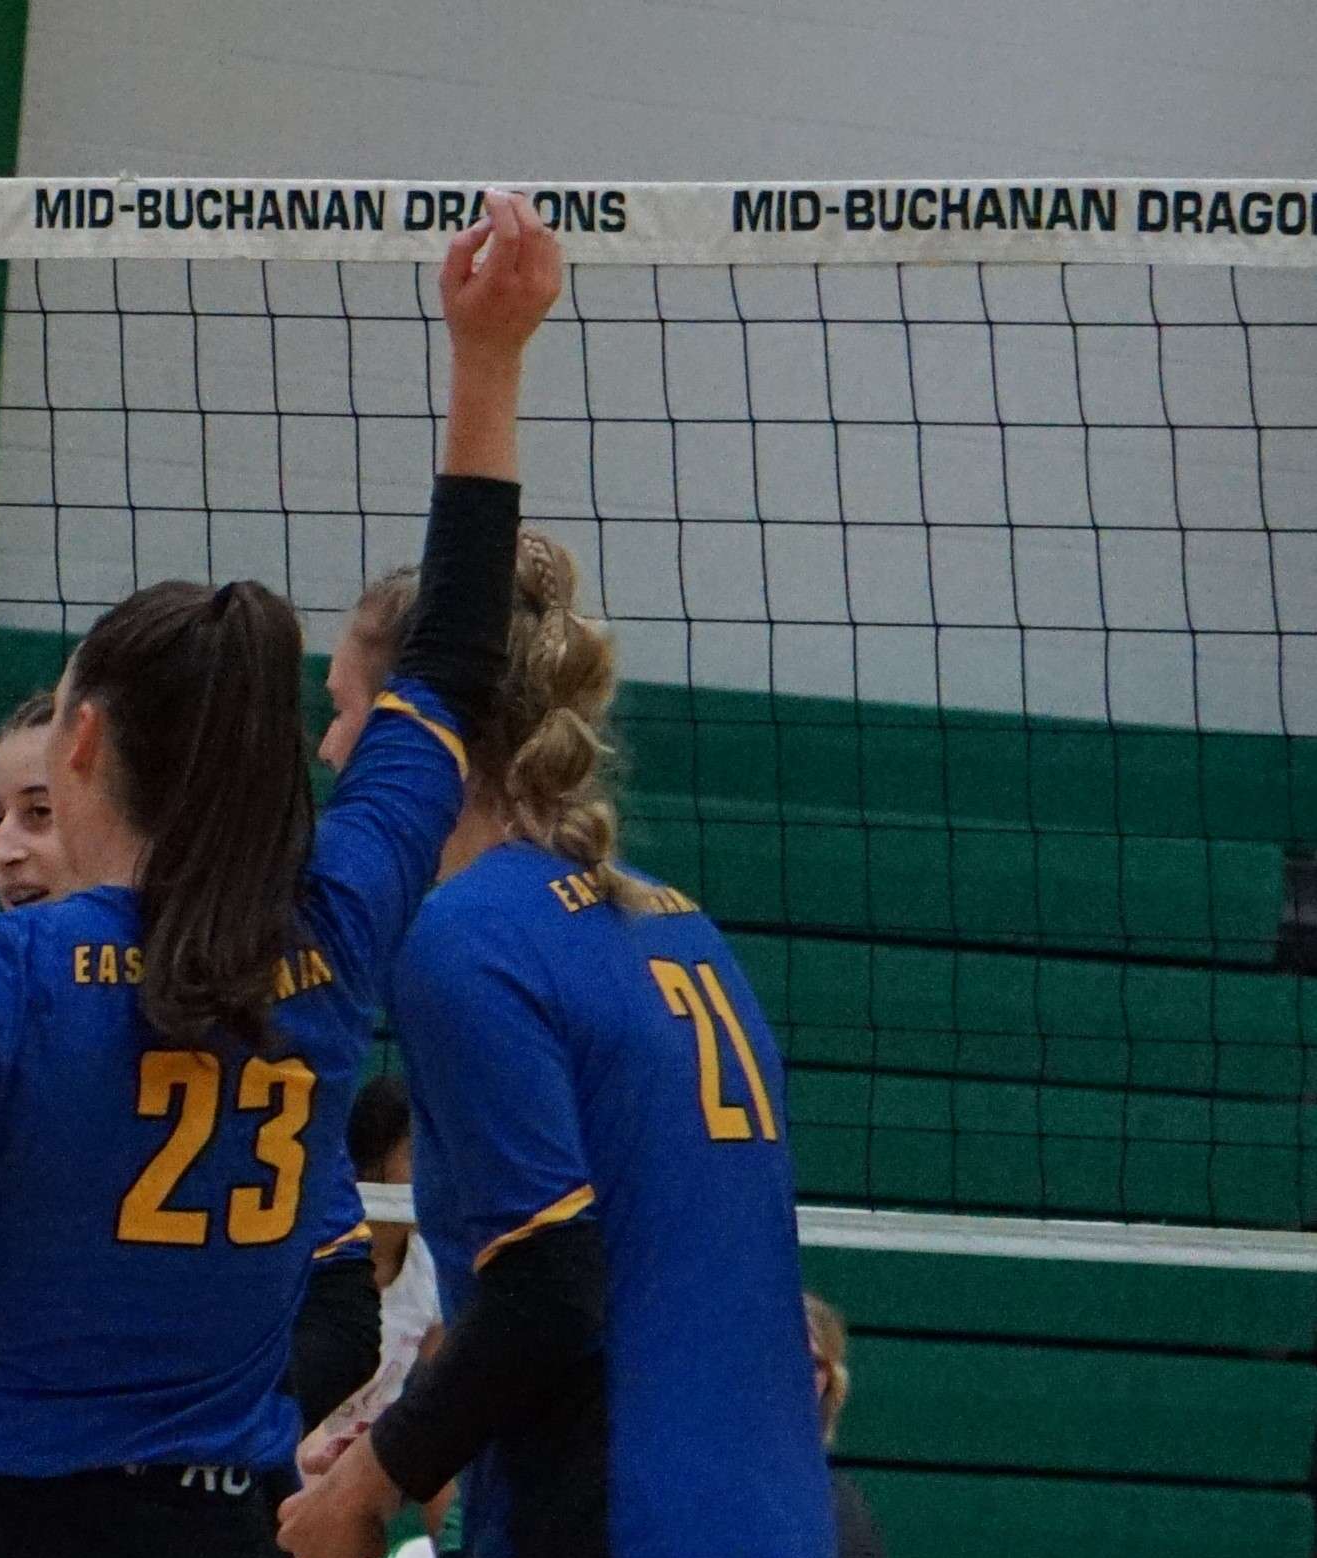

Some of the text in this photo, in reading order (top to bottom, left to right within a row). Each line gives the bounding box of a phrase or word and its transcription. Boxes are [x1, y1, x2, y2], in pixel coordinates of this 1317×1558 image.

[33, 187, 627, 234] MID-BUCHANAN DRAONS
[731, 186, 1119, 234] MID-BUCHANAN
[648, 957, 778, 1143] 21
[116, 1050, 317, 1246] 23
